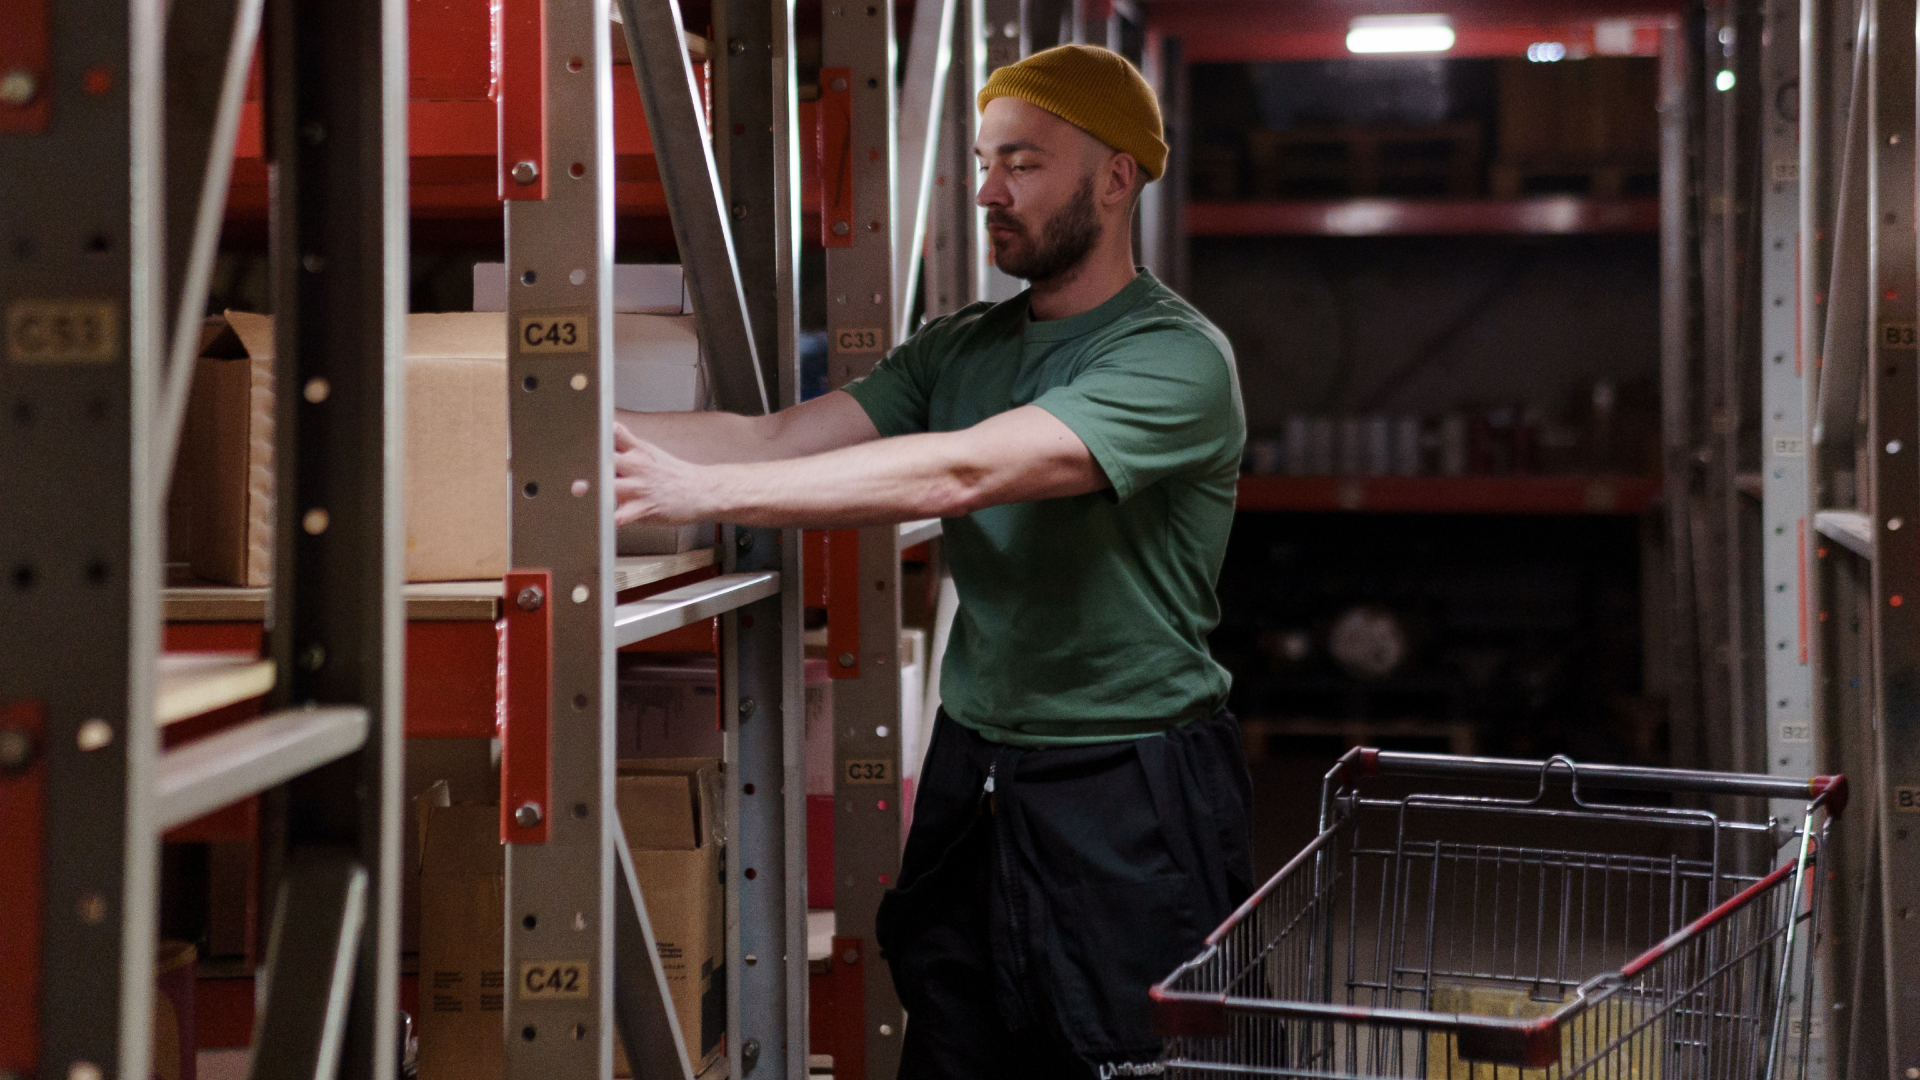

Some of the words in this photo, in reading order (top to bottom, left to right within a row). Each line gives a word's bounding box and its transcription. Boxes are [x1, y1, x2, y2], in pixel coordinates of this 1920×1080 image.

[524, 322, 577, 347] C43
[840, 332, 876, 349] C33
[1886, 327, 1917, 344] B3
[849, 763, 885, 779] C32
[526, 967, 579, 992] C42
